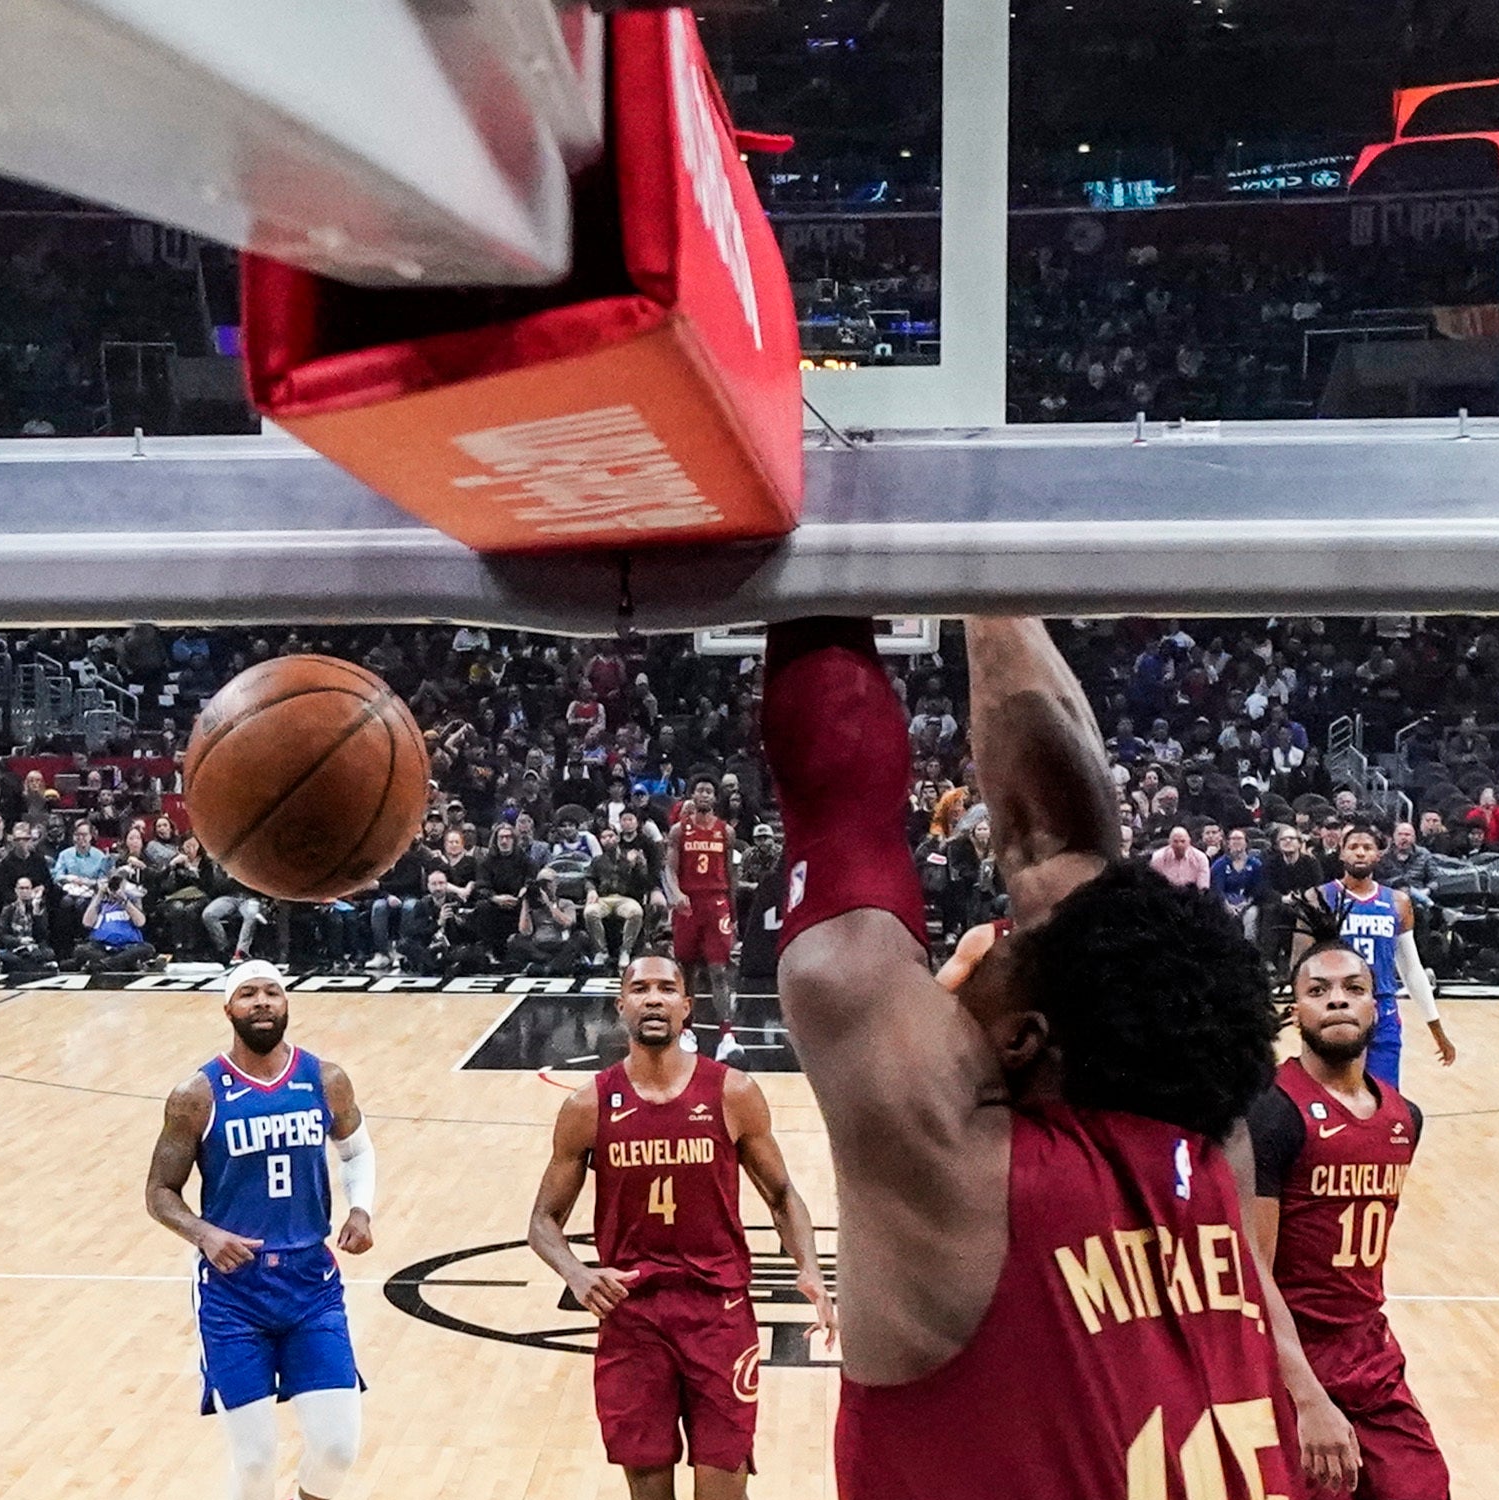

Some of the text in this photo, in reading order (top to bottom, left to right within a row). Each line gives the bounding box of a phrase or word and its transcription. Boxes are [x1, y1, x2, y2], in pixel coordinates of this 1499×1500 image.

[697, 854, 709, 874] 3
[1340, 913, 1395, 938] LIPPERS
[225, 1109, 324, 1157] CLIPPERS
[609, 1138, 714, 1168] CLEVELAND
[267, 1154, 292, 1198] 8
[1310, 1164, 1408, 1198] CLEVELAN
[648, 1175, 677, 1225] 4
[1332, 1201, 1387, 1267] 10
